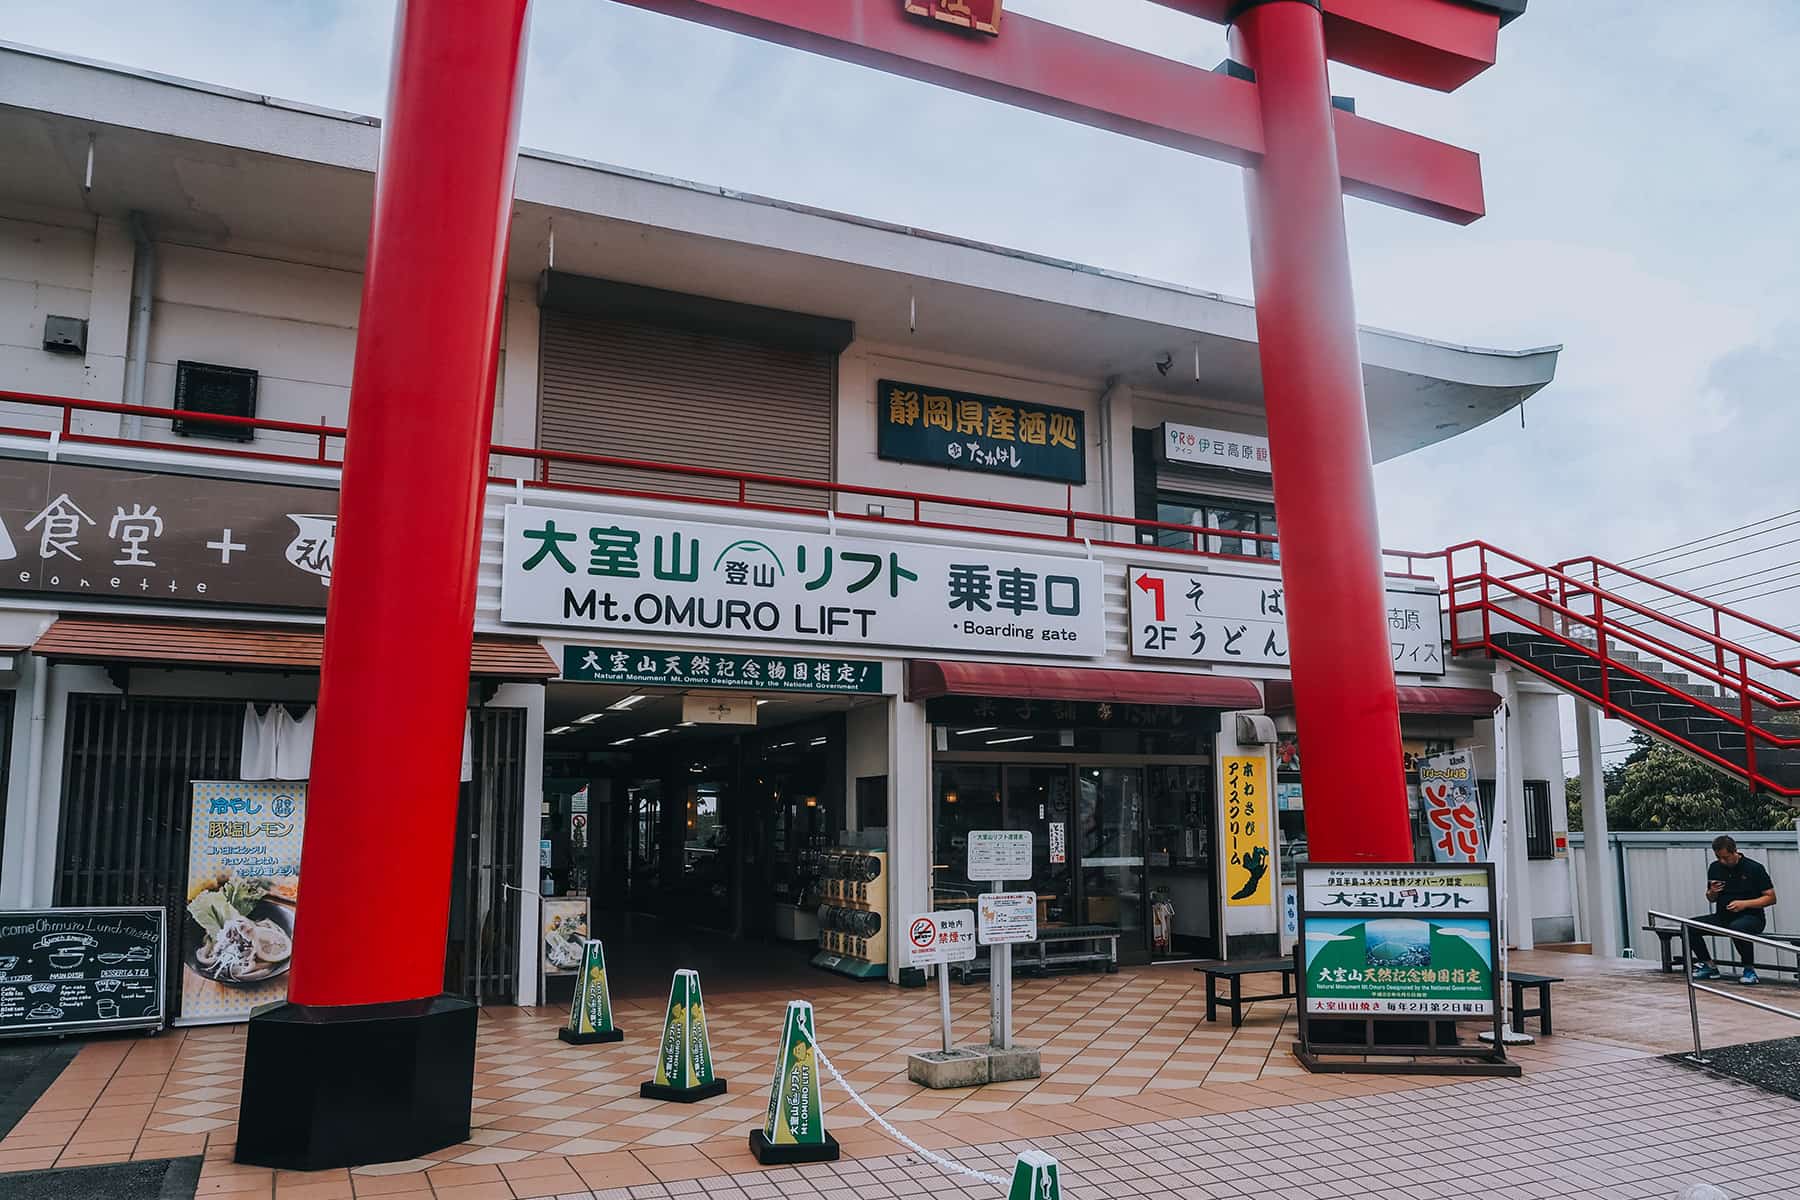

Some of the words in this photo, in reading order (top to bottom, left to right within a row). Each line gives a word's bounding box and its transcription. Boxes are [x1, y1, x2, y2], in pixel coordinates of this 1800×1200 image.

[889, 387, 1077, 449] 静岡県産酒処
[966, 441, 1022, 469] たかはし
[25, 493, 165, 567] 食堂
[522, 519, 700, 583] 大室山
[725, 560, 775, 588] 登山
[797, 544, 918, 598] リフト
[948, 563, 1081, 616] 乗車口
[563, 586, 780, 631] Mt.OMURO
[794, 603, 877, 637] LIFT
[1041, 627, 1077, 641] gate
[1143, 624, 1178, 651] 2F
[1188, 621, 1287, 657] うどん
[580, 649, 869, 684] 大室山天然記念物国指定!
[594, 672, 624, 681] Natural
[626, 673, 667, 682] Monument
[711, 678, 754, 687] Designated
[755, 679, 764, 688] by
[767, 679, 779, 687] the
[783, 681, 814, 689] National
[816, 682, 859, 690] Government
[208, 796, 262, 815] 冷やし
[1229, 762, 1241, 866] アイスクリーム
[208, 820, 295, 838] 豚塩レモン
[1319, 890, 1406, 908] 大室山
[1407, 890, 1473, 909] リフト
[940, 920, 963, 929] 敷地内
[939, 931, 974, 944] 禁煙です
[1318, 967, 1481, 983] 大室山天然記念物国指定
[1315, 1000, 1381, 1012] 大室山山焼き
[1387, 1002, 1484, 1013] 毎年2月第2日曜日
[791, 1066, 800, 1091] リフト
[802, 1065, 810, 1085] LIFT
[800, 1086, 809, 1136] Mt.OMURO
